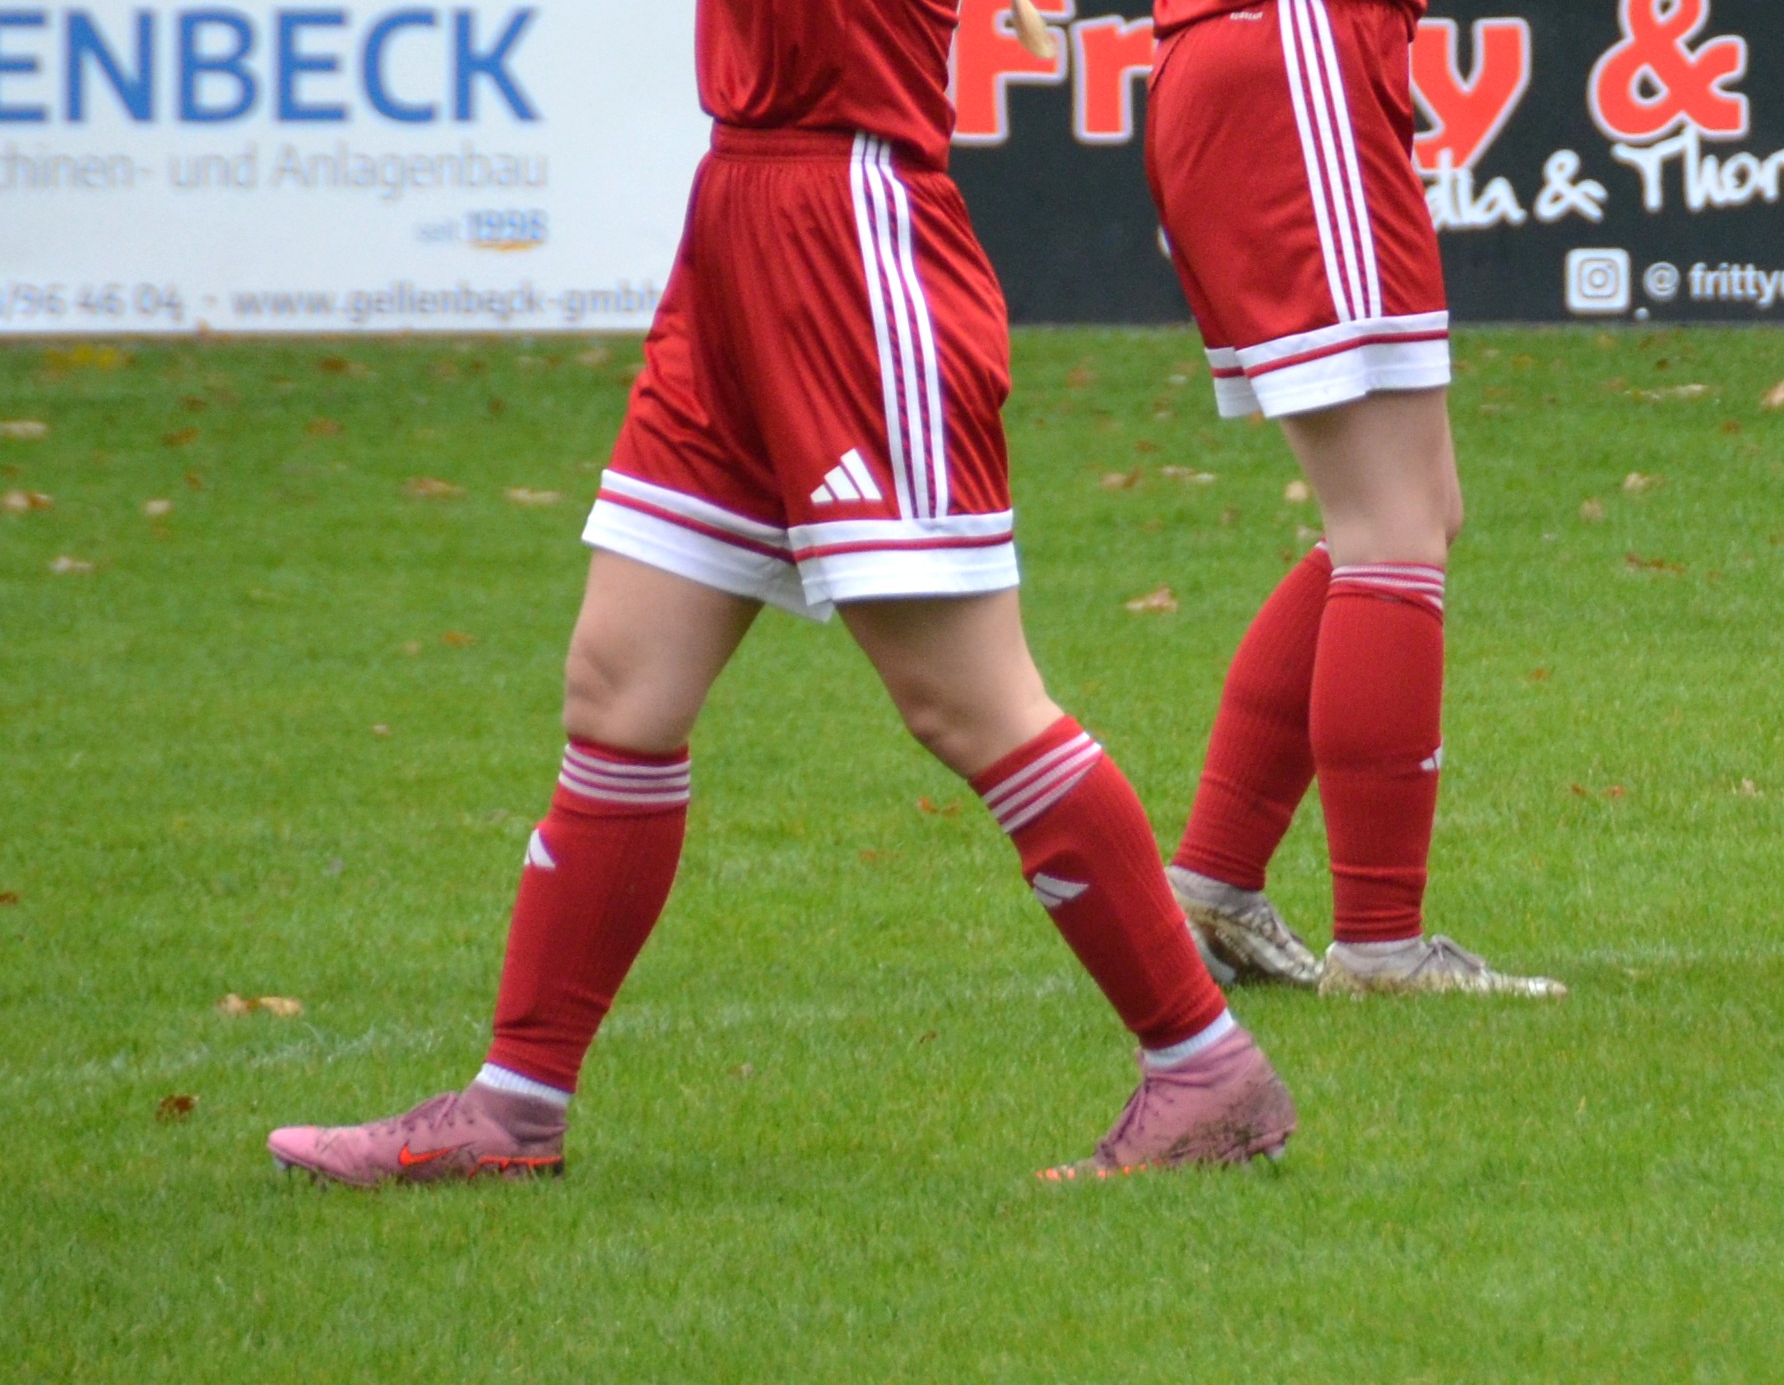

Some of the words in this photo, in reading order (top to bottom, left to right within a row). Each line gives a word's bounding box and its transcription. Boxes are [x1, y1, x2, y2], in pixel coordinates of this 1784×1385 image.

[168, 142, 257, 190] und
[270, 140, 550, 200] Anlagenbau
[1535, 148, 1608, 221] &
